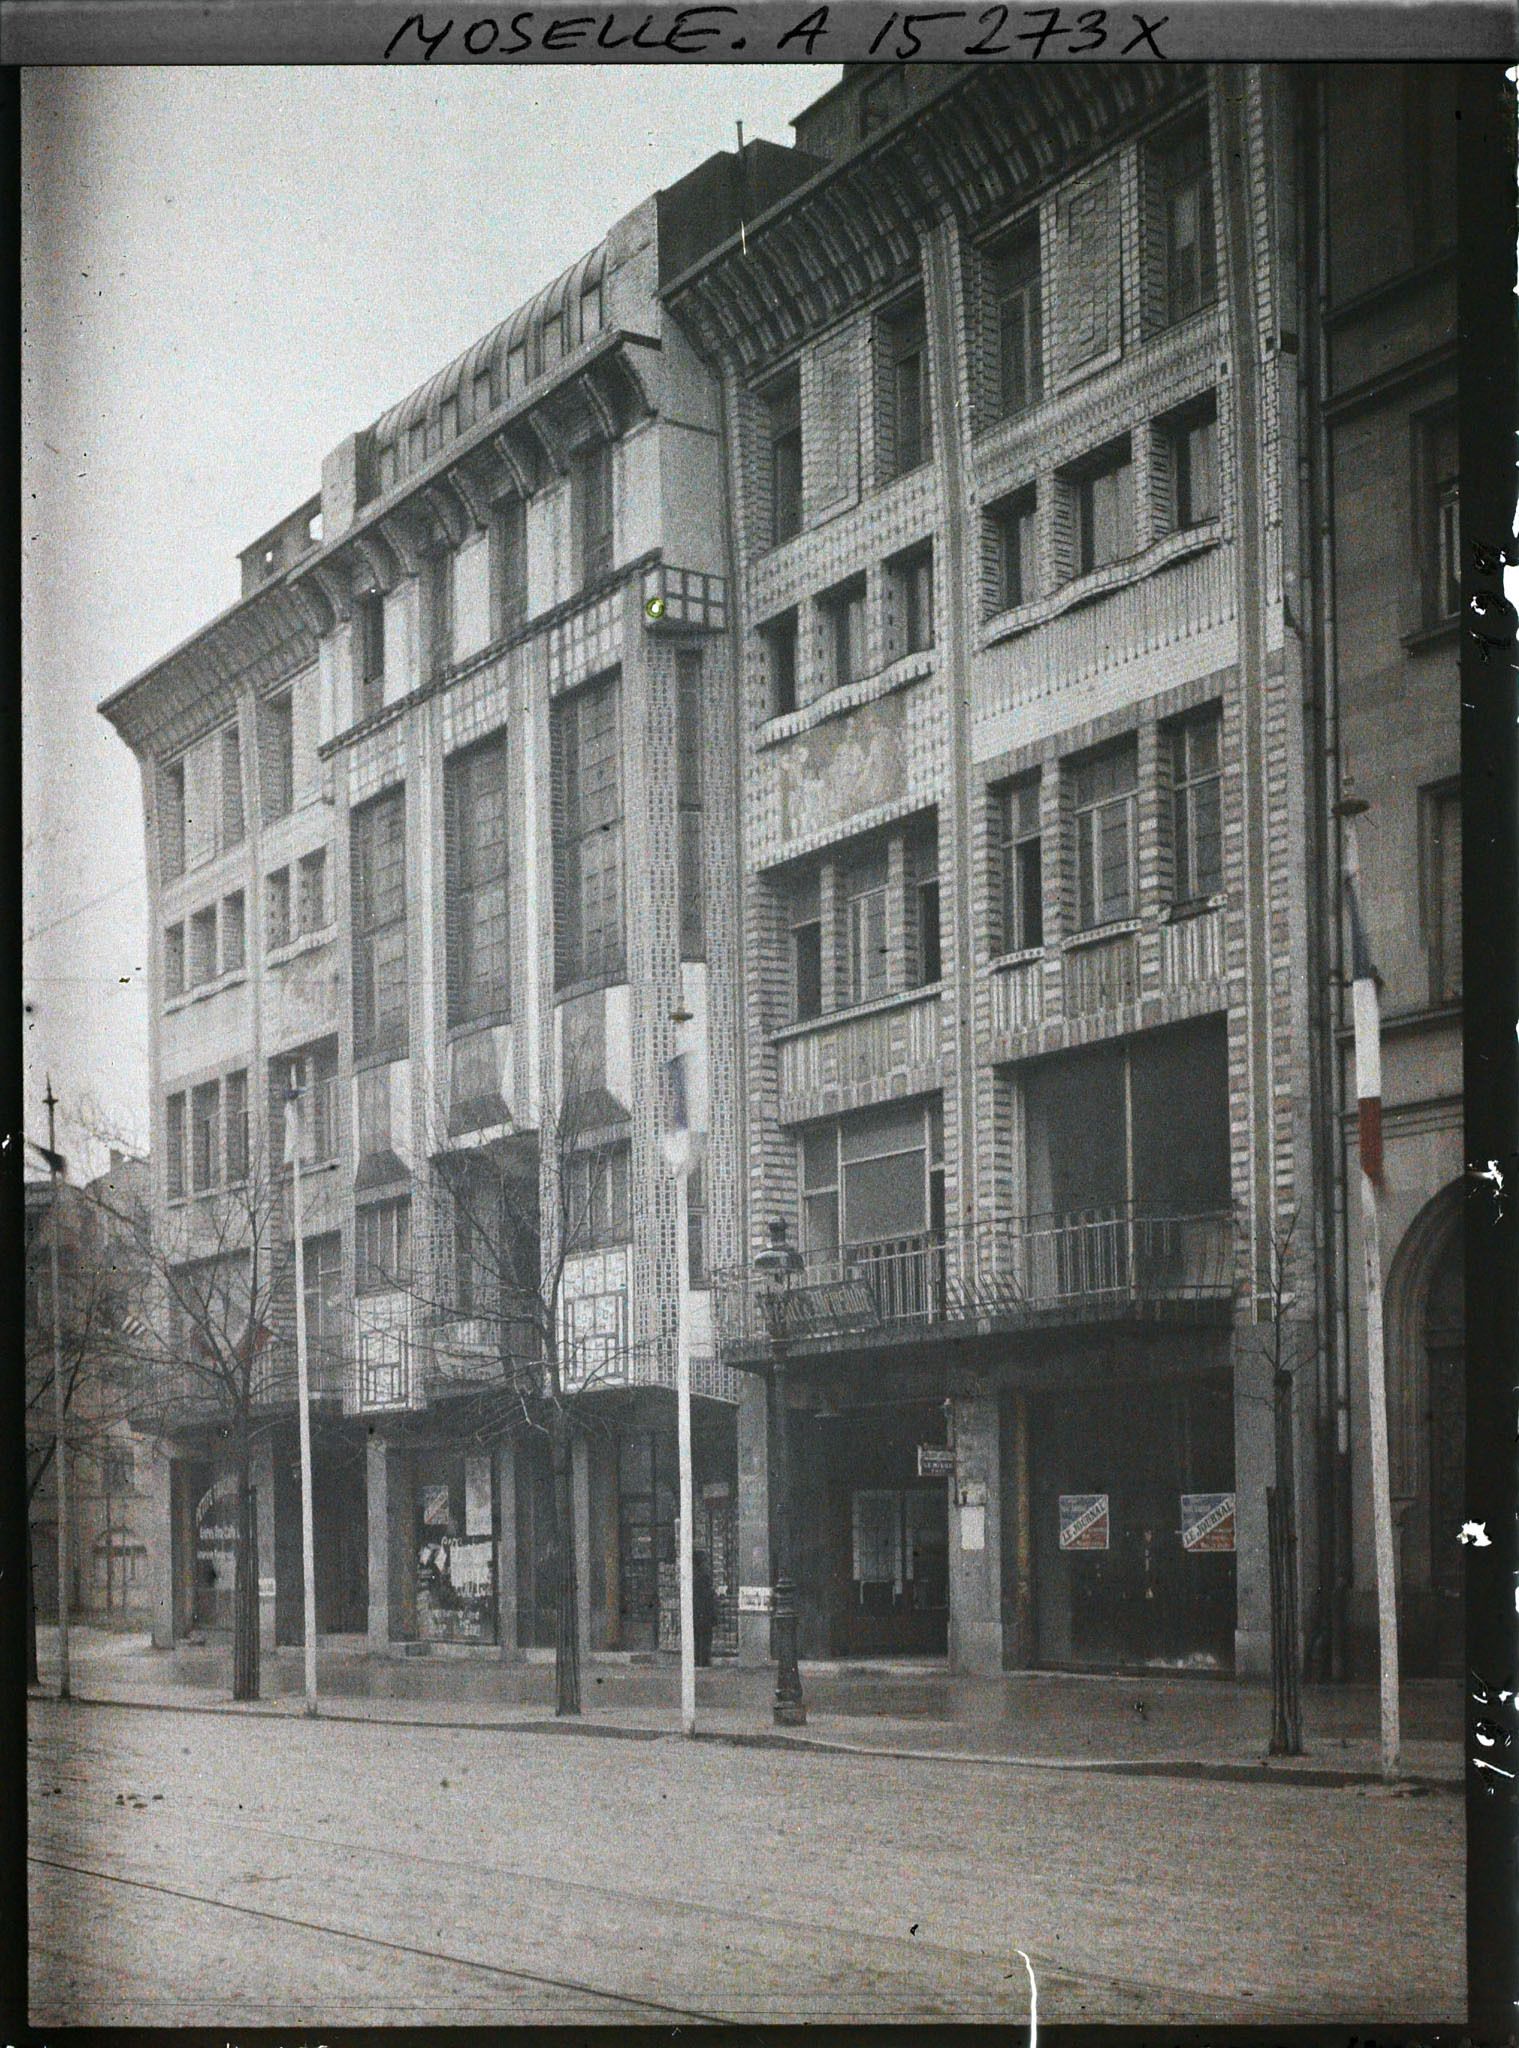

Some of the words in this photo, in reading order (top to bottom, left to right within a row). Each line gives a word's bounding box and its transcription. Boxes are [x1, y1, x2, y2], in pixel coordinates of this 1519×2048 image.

[777, 5, 829, 56] A
[1071, 1501, 1106, 1536] JOURNAL
[1195, 1501, 1233, 1537] JOURNAL
